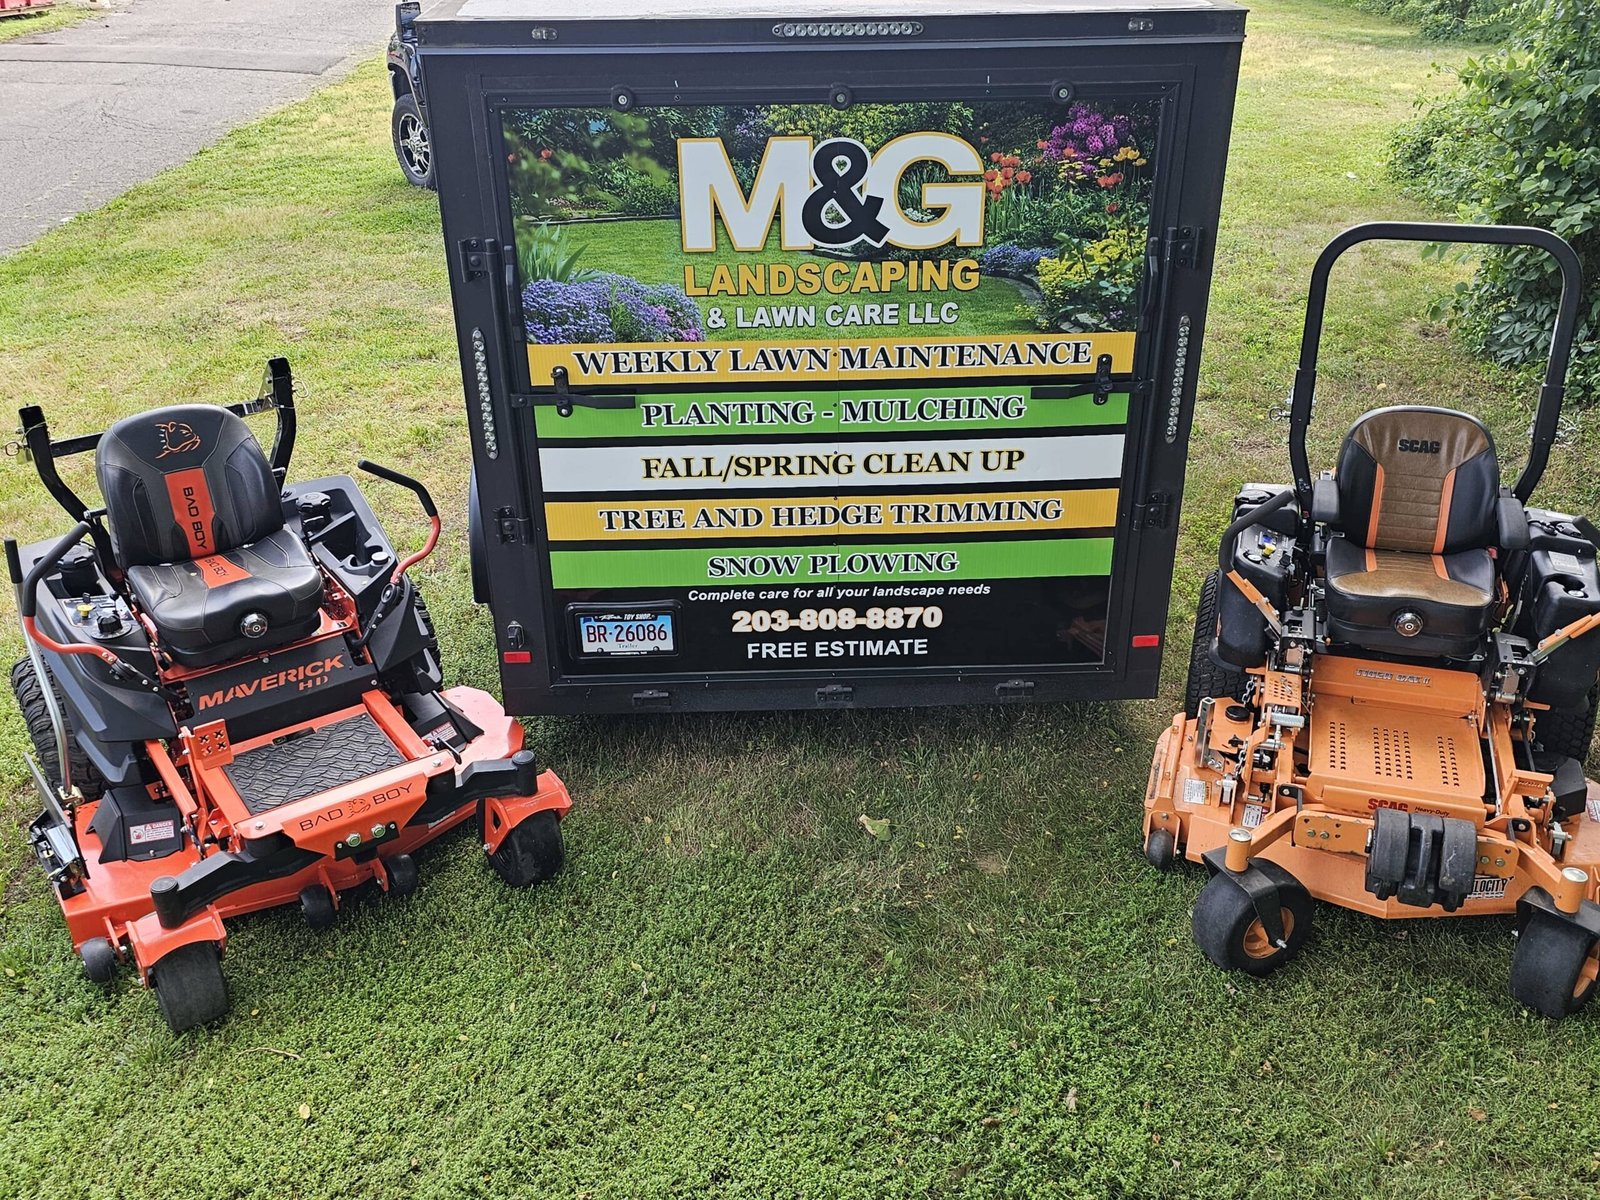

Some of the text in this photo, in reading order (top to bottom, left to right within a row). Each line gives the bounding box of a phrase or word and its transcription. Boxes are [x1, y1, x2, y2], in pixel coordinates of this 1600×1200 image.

[676, 131, 986, 253] M&G
[683, 259, 981, 297] LANDSCAPING
[707, 301, 960, 330] & LAWN CARE LLC
[572, 340, 1093, 376] WEEKLY LAWN MAINTENANCE
[641, 401, 816, 427] PLANTING
[841, 395, 1026, 423] MULCHING
[1398, 438, 1441, 453] SCAG
[641, 449, 1025, 483] FALL/SPRING CLEAN UP
[183, 487, 208, 550] BAD BOY
[598, 498, 1064, 531] TREE AND HEDGE TRIMMING
[707, 551, 960, 578] SNOW PLOWING
[688, 584, 991, 602] Complete care for all your landscape needs
[731, 606, 943, 633] 203-808-8870
[747, 639, 929, 659] FREE ESTIMATE
[199, 654, 345, 711] MAVERICK
[298, 676, 329, 691] HD
[299, 783, 413, 831] BAD BOY
[1367, 798, 1450, 817] SCAG Heavy-Duty
[1473, 879, 1507, 892] LOCITY
